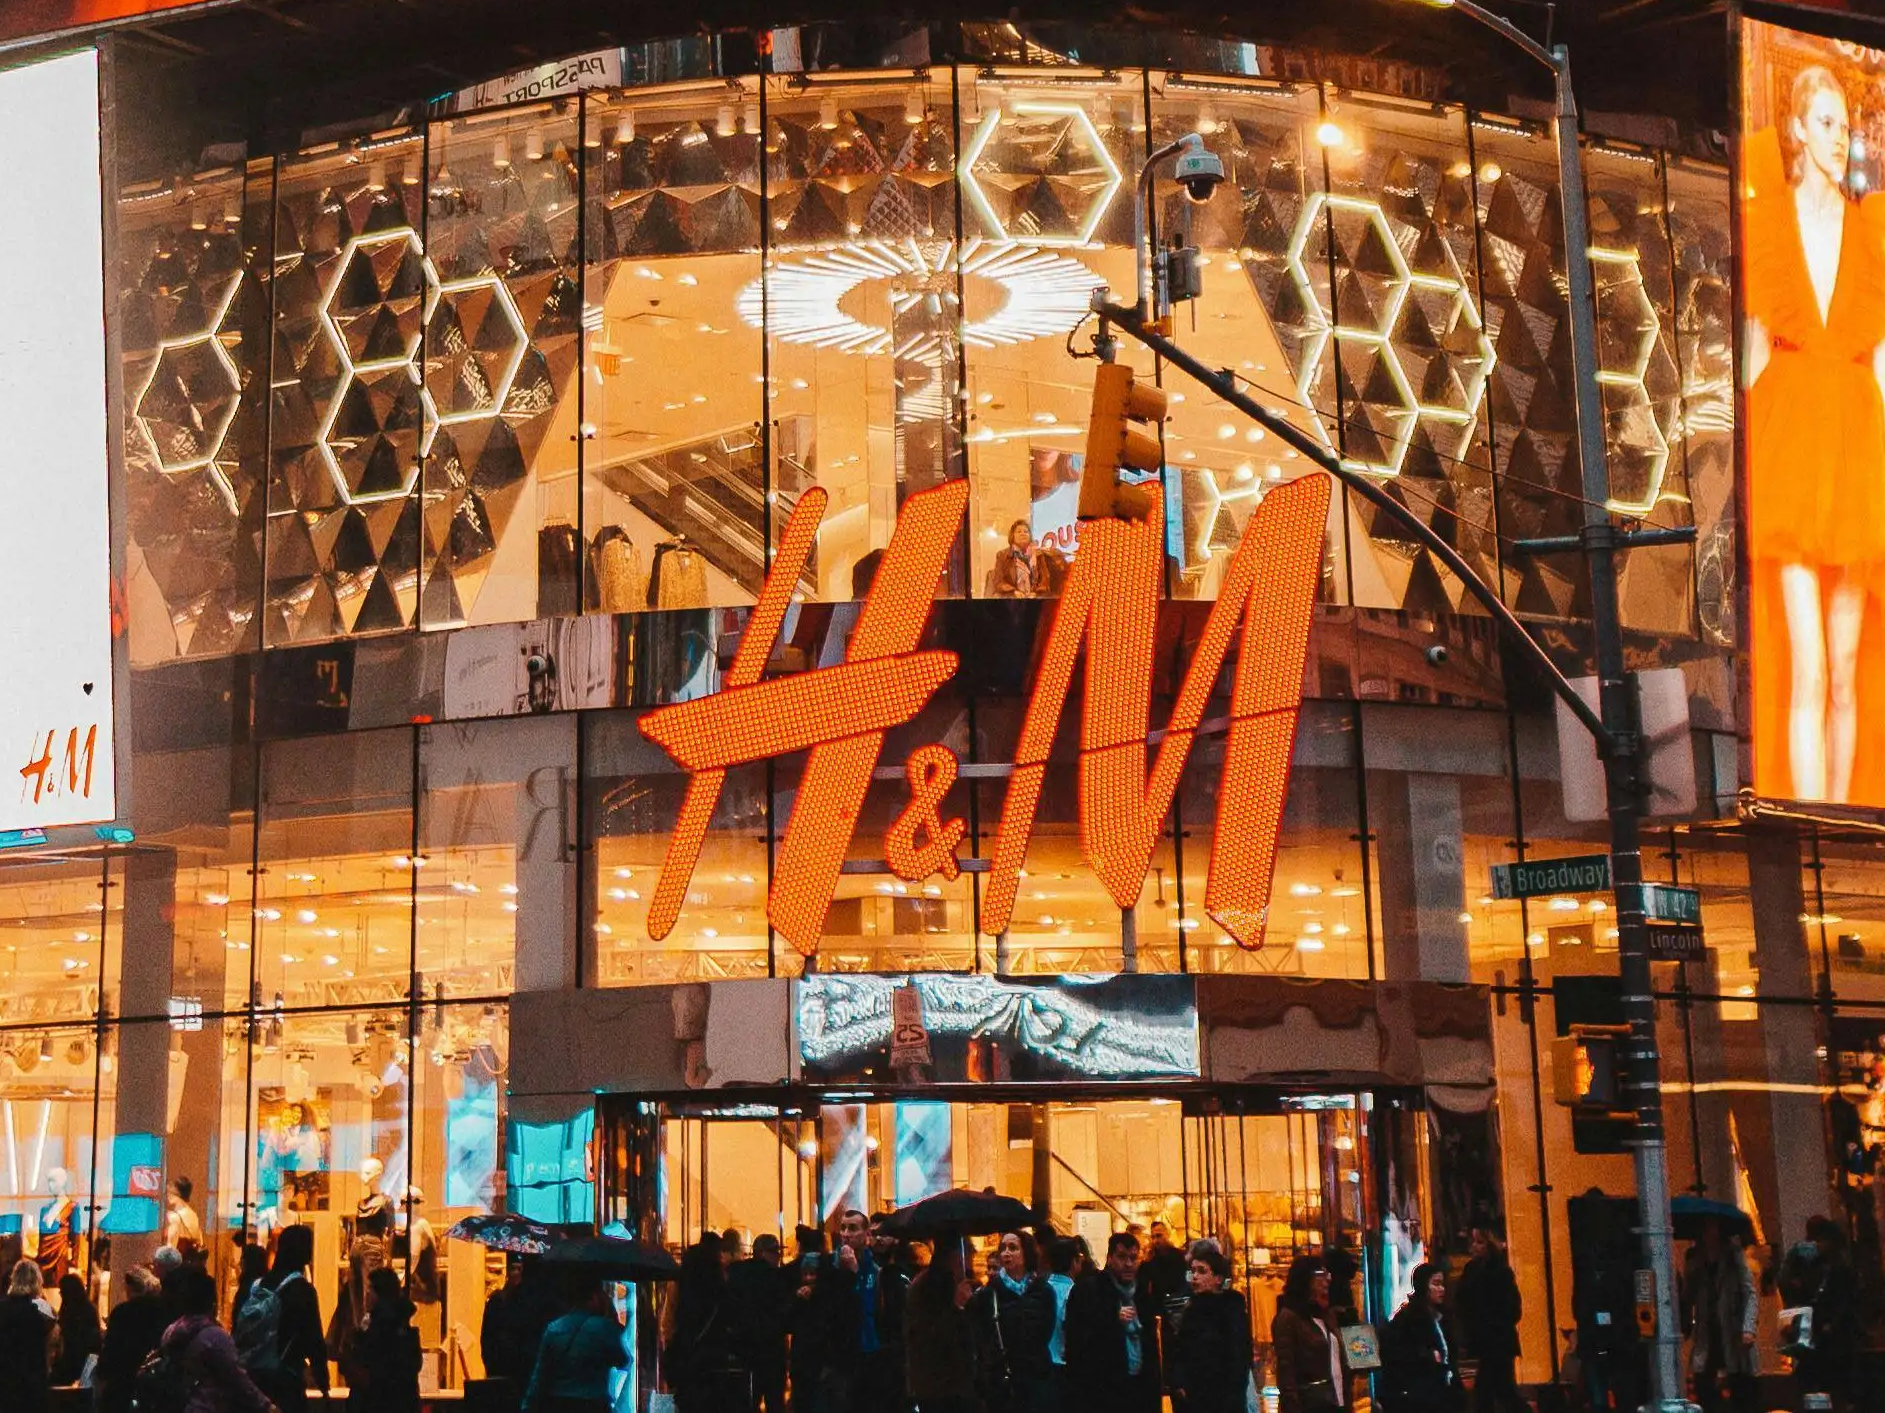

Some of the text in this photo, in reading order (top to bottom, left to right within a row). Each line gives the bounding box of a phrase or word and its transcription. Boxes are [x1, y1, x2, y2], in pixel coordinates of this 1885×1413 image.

[637, 472, 1333, 958] H&M
[1516, 863, 1606, 894] Broadway
[1649, 930, 1702, 951] Lincoln
